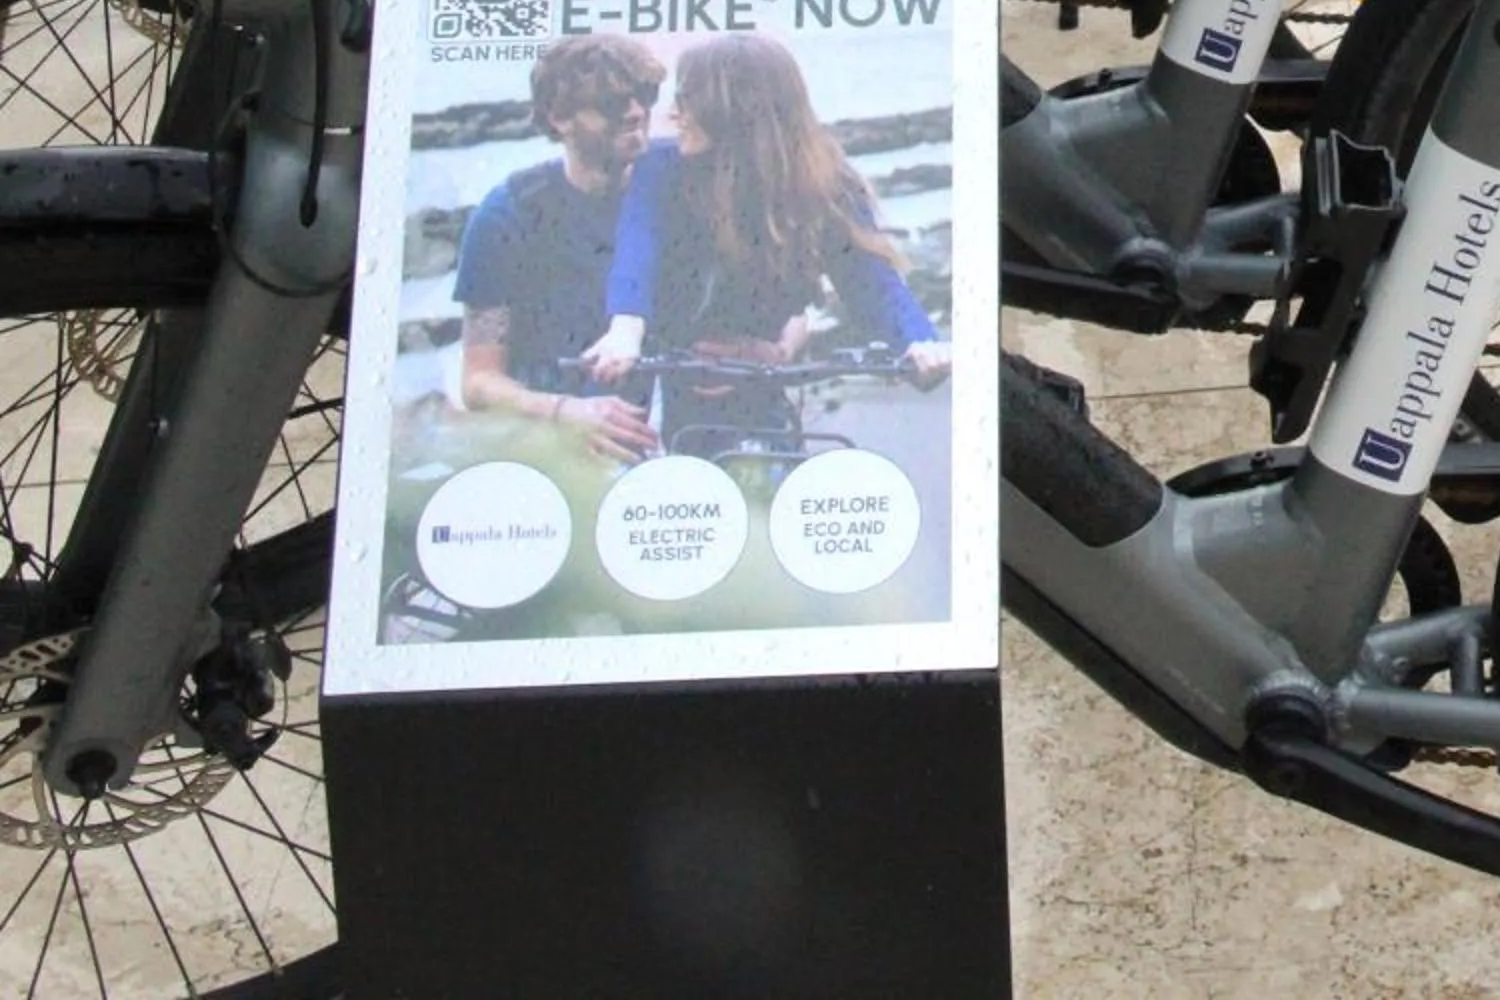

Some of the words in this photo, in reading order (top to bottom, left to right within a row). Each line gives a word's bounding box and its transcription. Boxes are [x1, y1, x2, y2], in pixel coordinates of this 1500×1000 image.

[431, 45, 490, 63] SCAN
[1351, 315, 1455, 483] Uappala
[623, 503, 721, 522] 60-100KM
[801, 496, 890, 515] EXPLORE
[629, 527, 716, 545] ELECTRIC
[804, 522, 842, 538] ECO
[847, 519, 886, 536] AND
[640, 545, 704, 561] ASSIST
[815, 538, 873, 554] LOCAL
